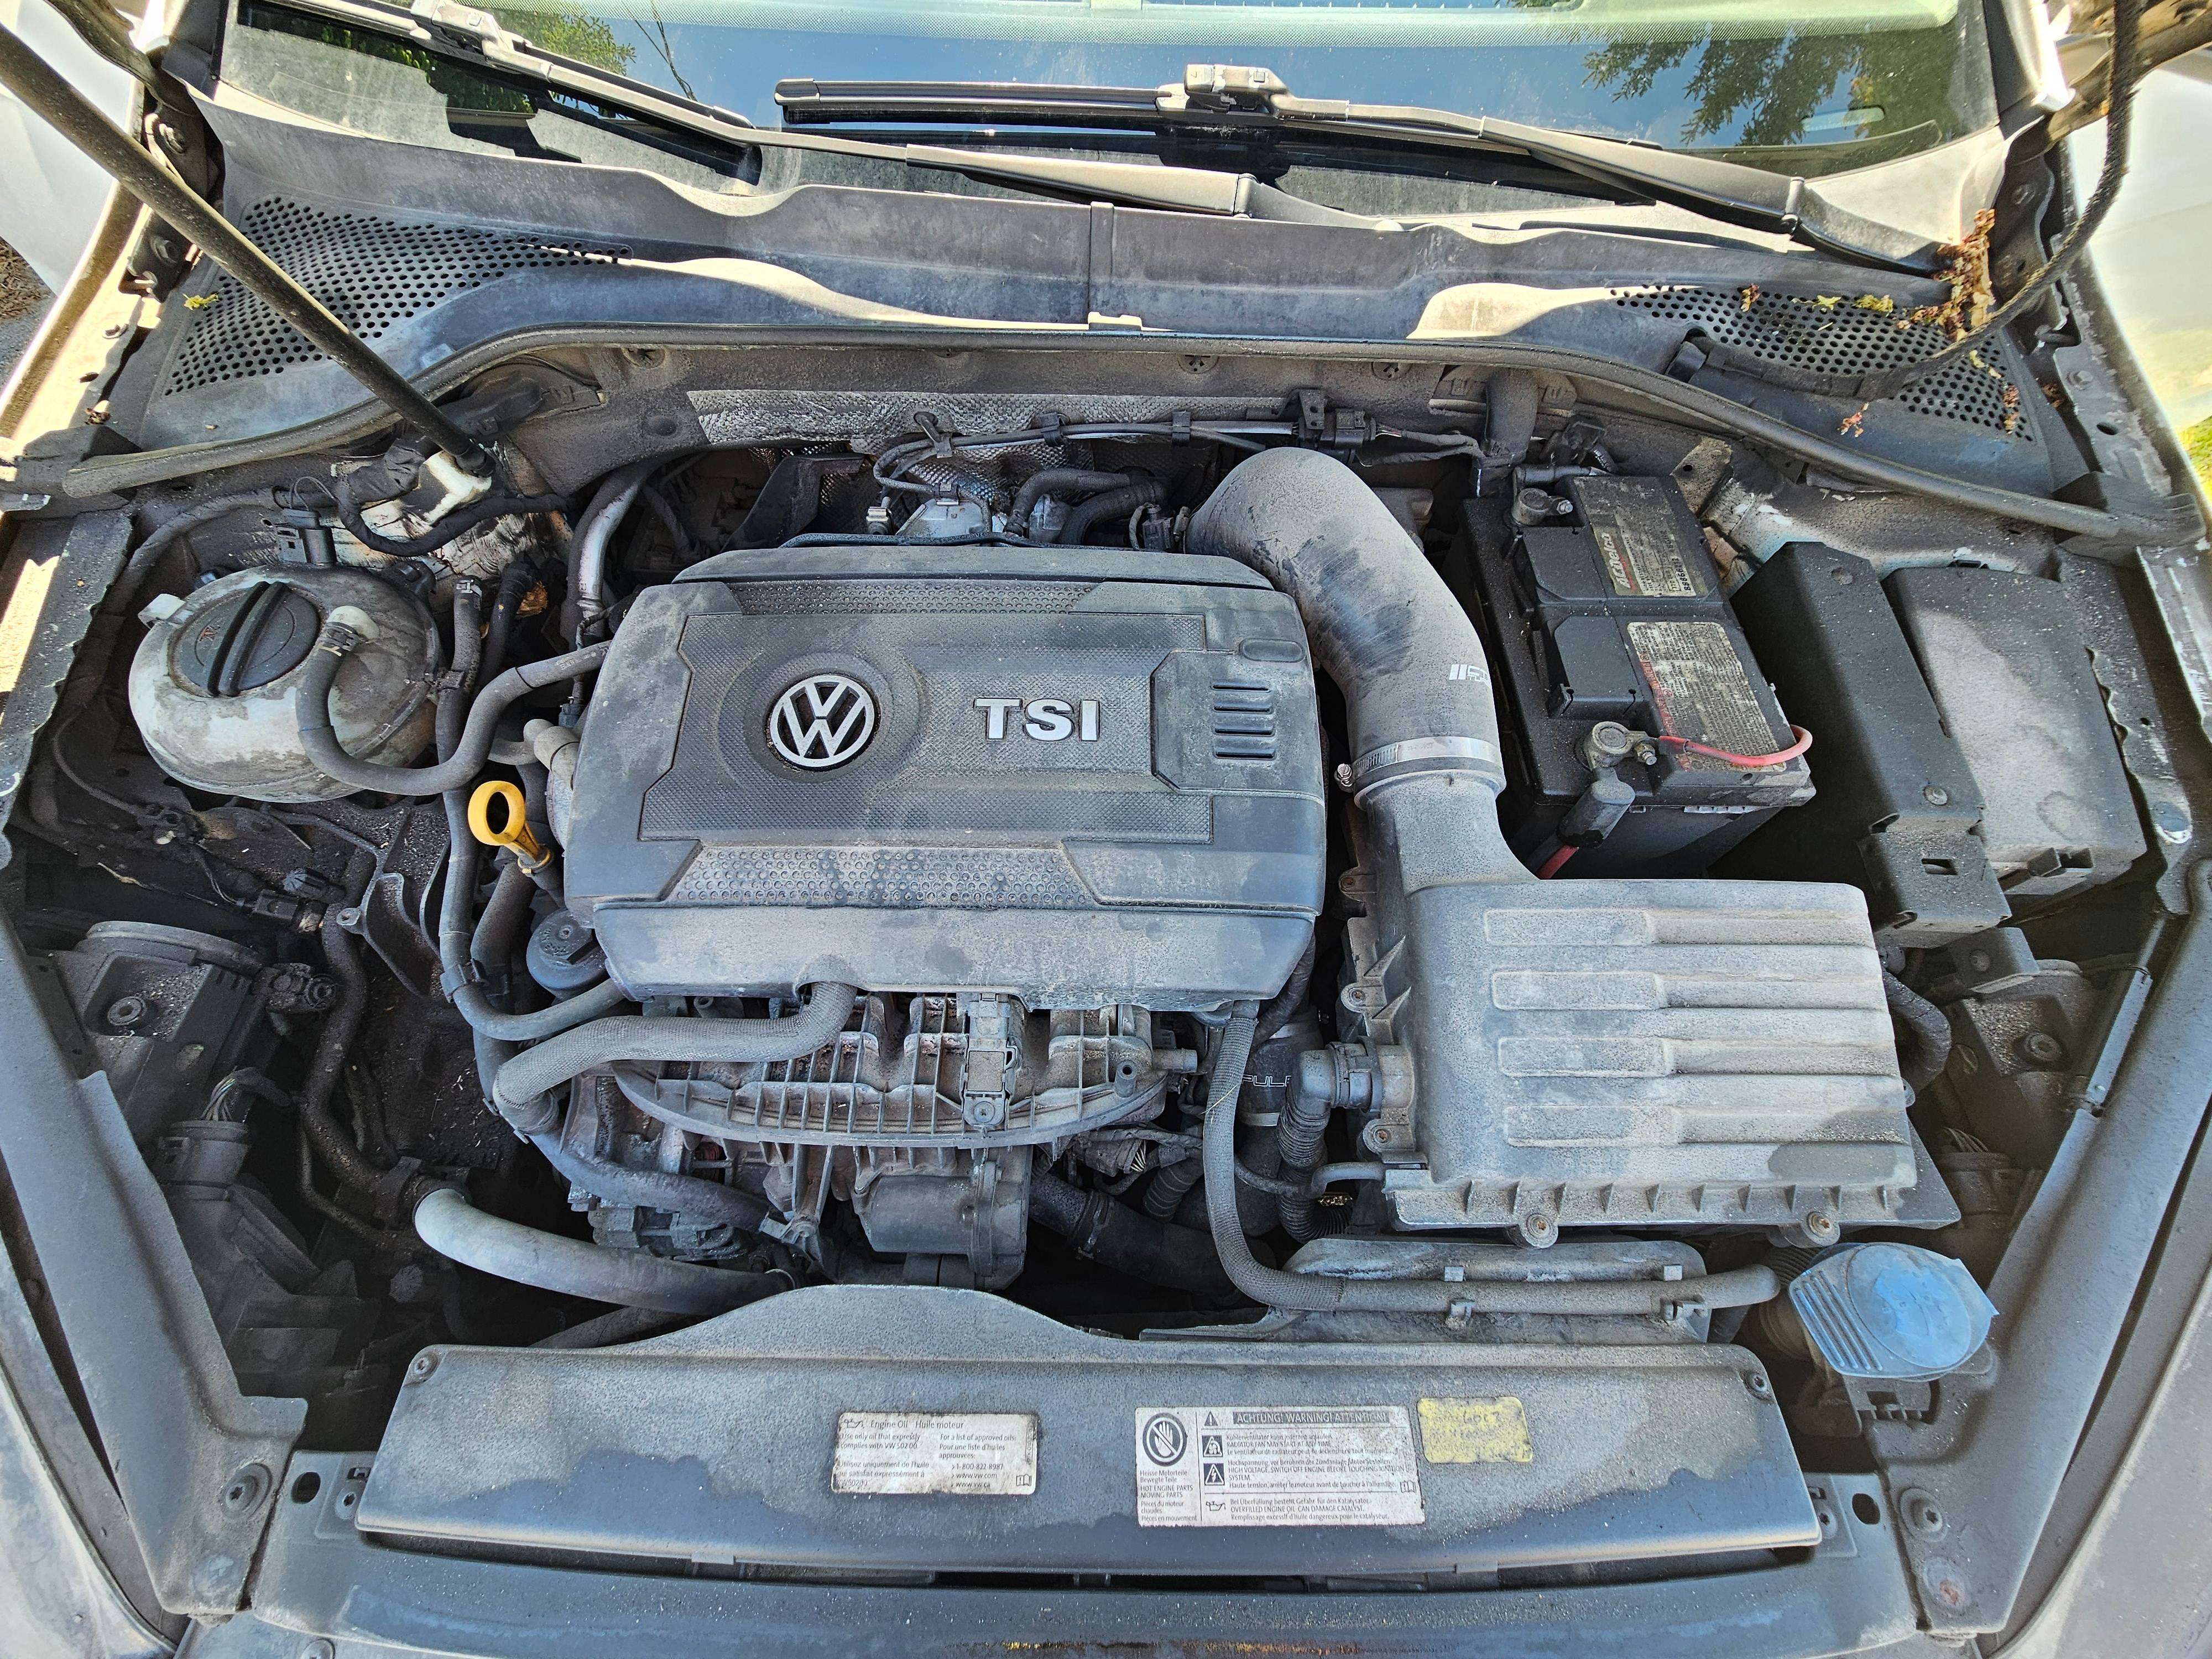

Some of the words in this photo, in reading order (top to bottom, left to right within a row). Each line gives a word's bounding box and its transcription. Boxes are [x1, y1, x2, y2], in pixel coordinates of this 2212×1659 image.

[1601, 532, 1632, 588] ACDelco
[771, 675, 875, 766] VW
[975, 697, 1100, 742] TSI
[1237, 1412, 1284, 1423] ACHTUNG!
[1286, 1412, 1332, 1422] WARNING!
[871, 1420, 895, 1430] Engine
[898, 1420, 908, 1428] Oil
[916, 1420, 935, 1428] Huile
[855, 1433, 867, 1441] only
[892, 1433, 920, 1442] expressly
[975, 1433, 1004, 1442] approved
[840, 1442, 868, 1451] complies
[982, 1443, 1005, 1451] d'huiles
[1298, 1448, 1311, 1457] peut
[901, 1460, 910, 1468] de
[911, 1460, 930, 1469] l'huile
[848, 1469, 873, 1478] satisfait
[874, 1469, 919, 1479] expressément
[1340, 1480, 1361, 1489] toucher
[1308, 1513, 1337, 1521] dangereux
